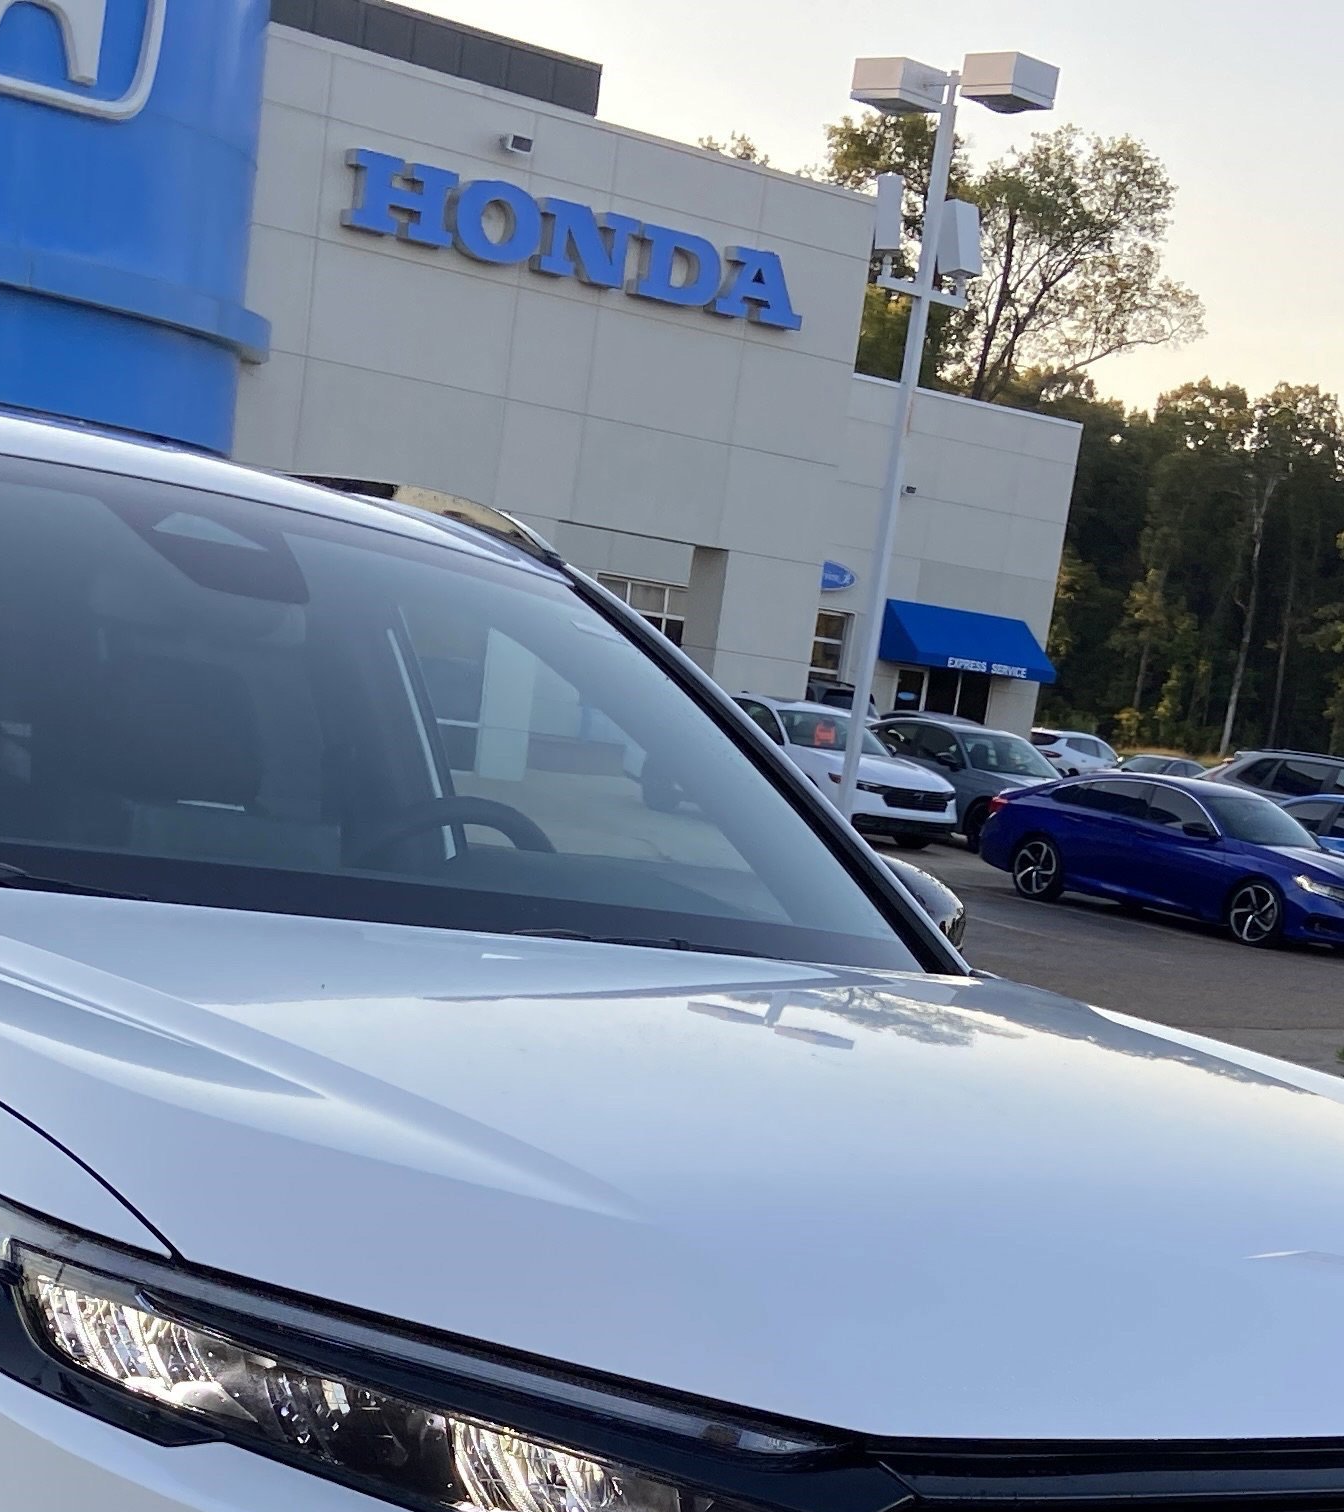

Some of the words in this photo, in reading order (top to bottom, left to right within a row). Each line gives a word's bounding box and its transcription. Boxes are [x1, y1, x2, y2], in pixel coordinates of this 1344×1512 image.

[341, 148, 801, 331] HONDA
[947, 656, 987, 673] EXPRESS
[991, 663, 1027, 679] SERVICE
